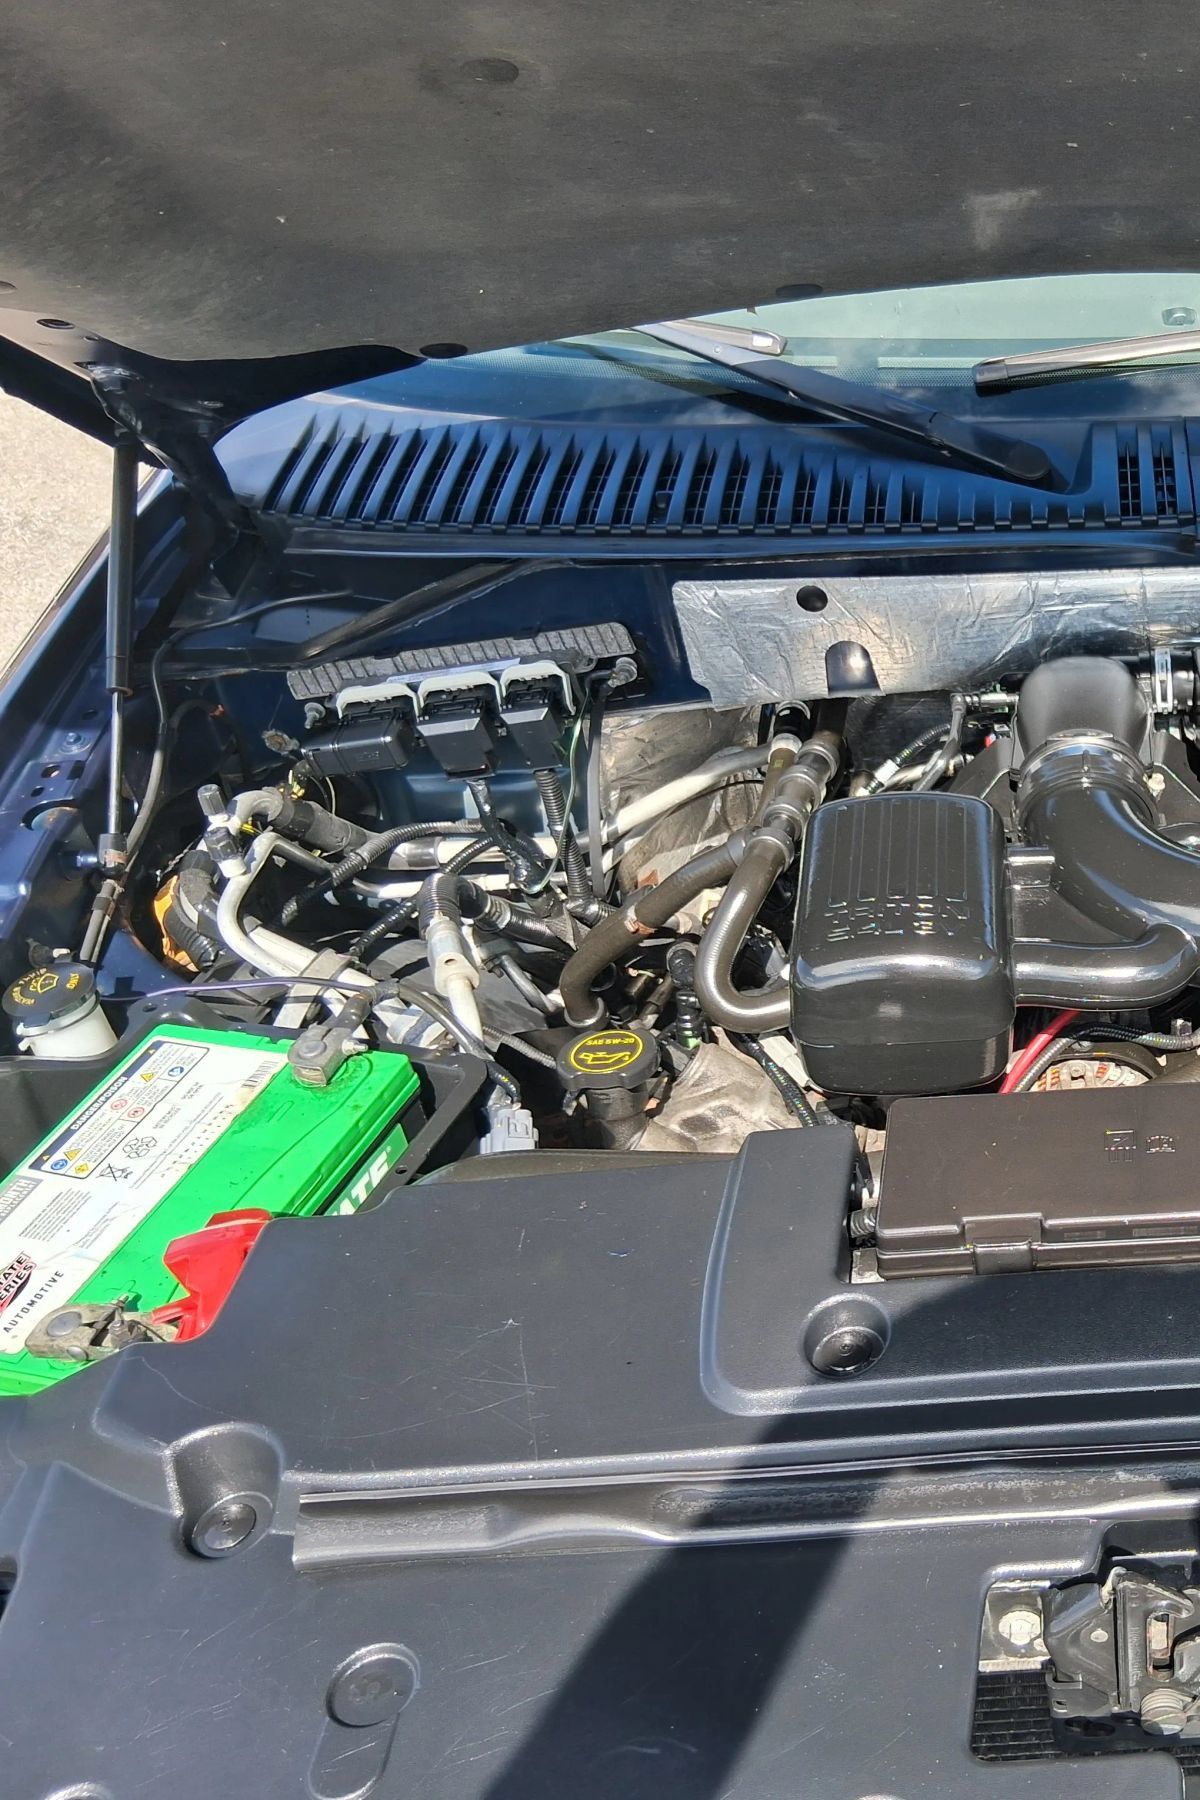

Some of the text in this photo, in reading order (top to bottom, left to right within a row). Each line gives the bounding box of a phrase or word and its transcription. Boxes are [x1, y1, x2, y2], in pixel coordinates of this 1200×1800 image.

[586, 1037, 635, 1046] SAE 5W-20
[69, 1076, 128, 1130] DANGER/POISON
[333, 1150, 389, 1215] ATE
[0, 1264, 33, 1301] ERIES
[3, 1270, 65, 1333] AUTOMOTIVE
